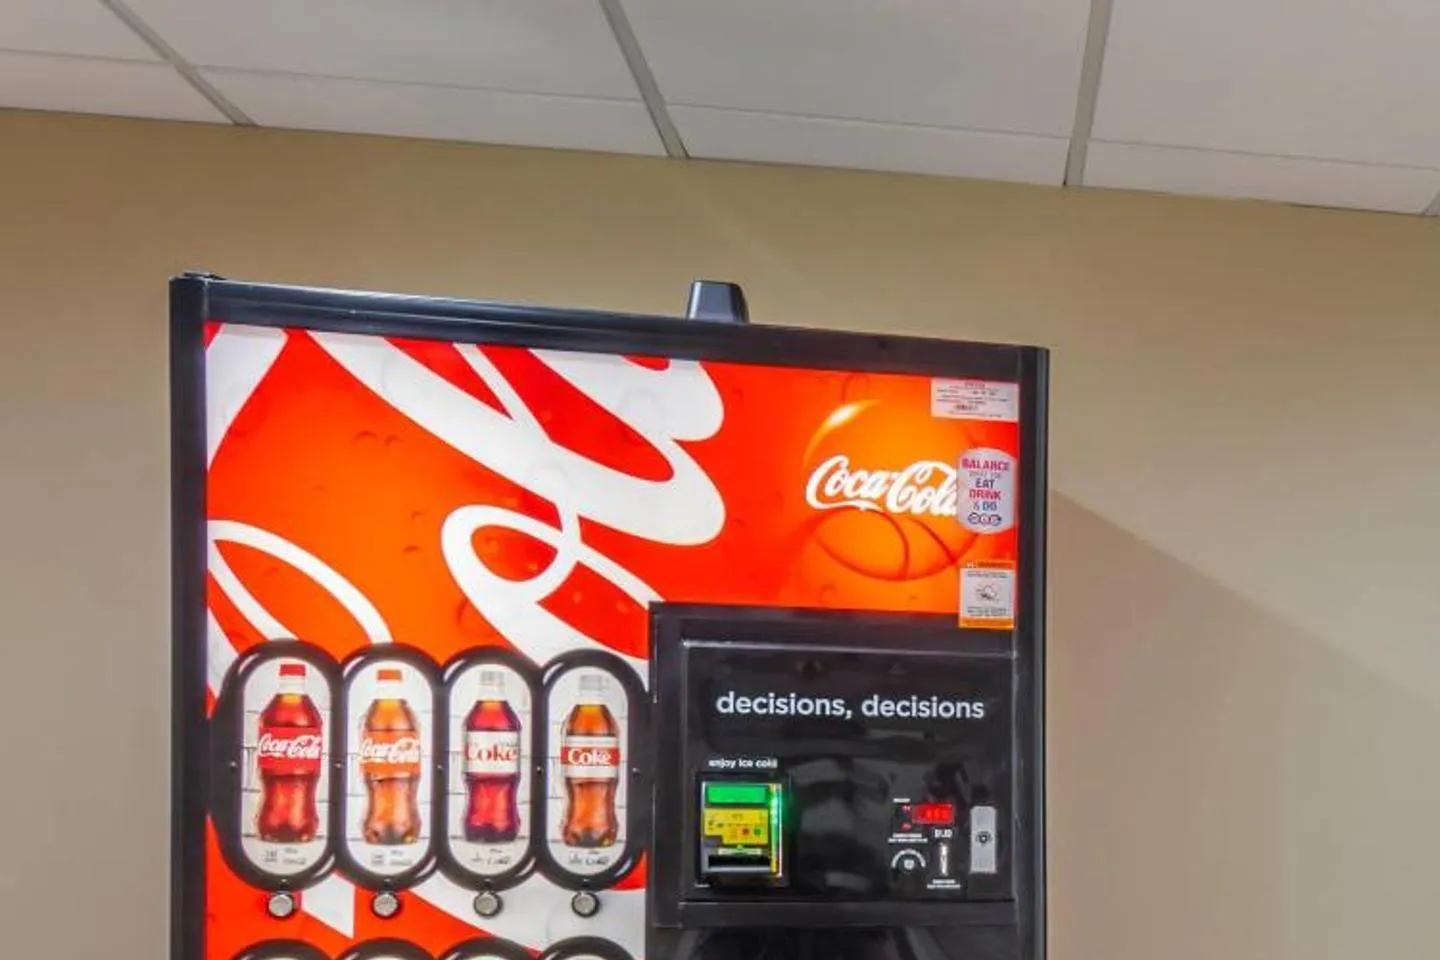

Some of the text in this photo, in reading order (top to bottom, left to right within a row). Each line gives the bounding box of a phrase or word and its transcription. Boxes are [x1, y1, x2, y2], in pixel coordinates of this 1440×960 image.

[962, 458, 1010, 471] BALANCE
[806, 455, 957, 517] Coca-Cola
[975, 478, 995, 489] EAT
[969, 489, 1001, 500] DRINK
[982, 501, 997, 511] DO
[716, 691, 985, 719] decisions, decisions
[259, 732, 322, 760] Coca-Cola
[464, 743, 518, 762] Coke
[567, 746, 612, 765] Coke
[708, 759, 736, 769] enjoy
